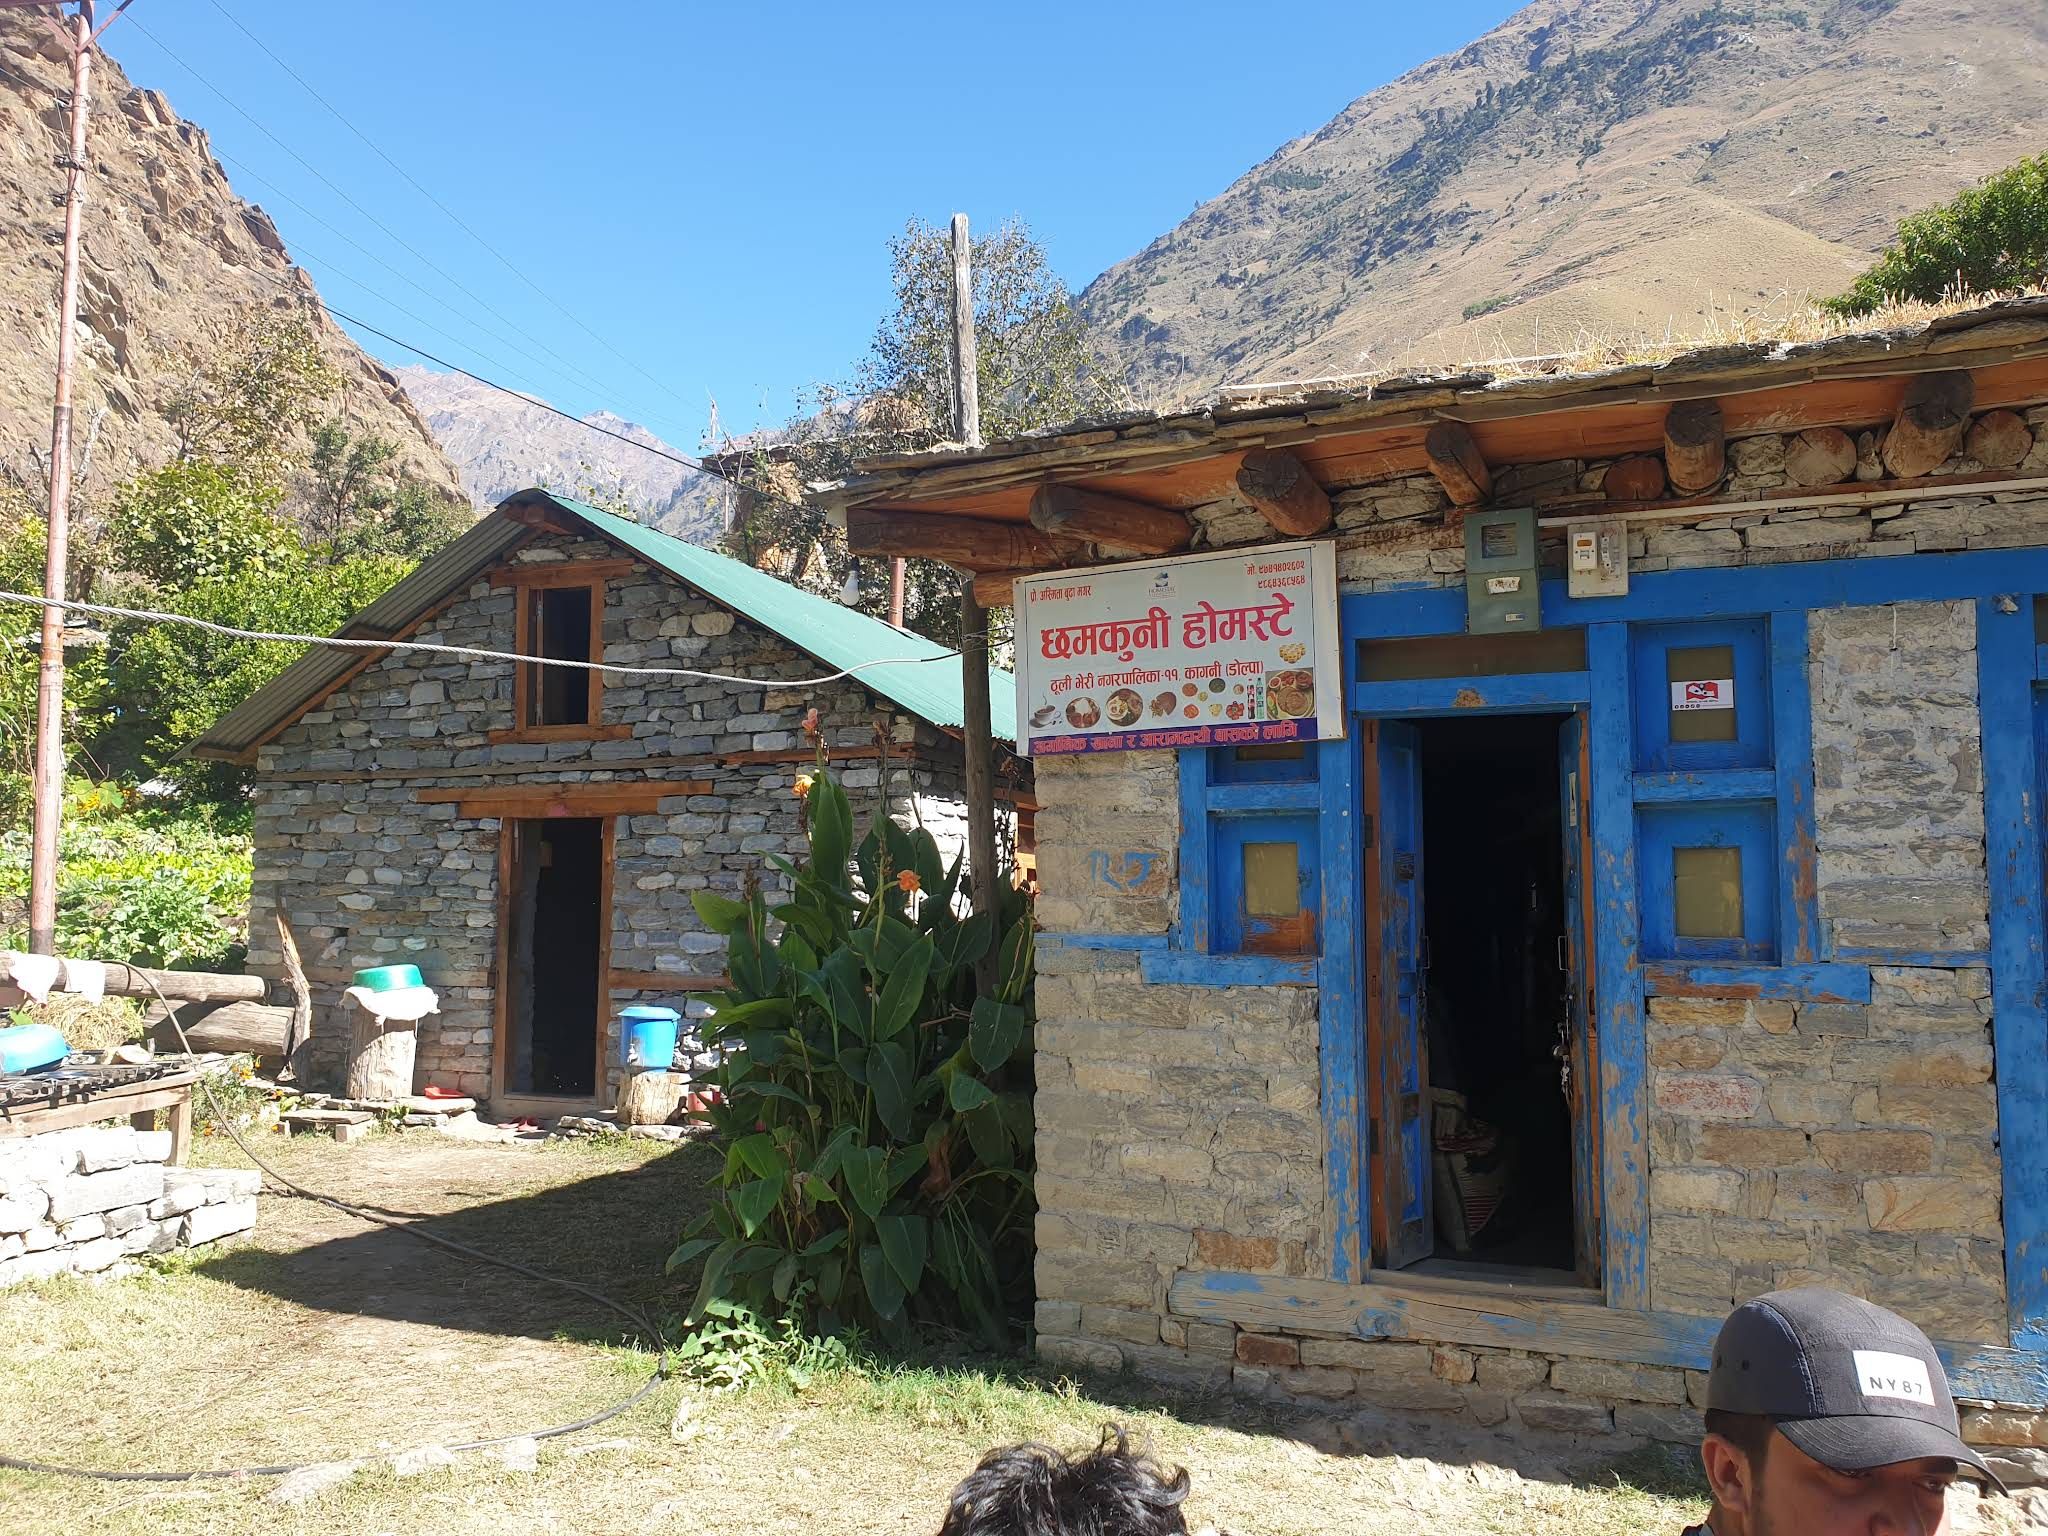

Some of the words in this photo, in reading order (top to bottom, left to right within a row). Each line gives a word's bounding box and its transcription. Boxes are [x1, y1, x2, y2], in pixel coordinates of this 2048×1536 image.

[1040, 587, 1063, 601] अस्मिता
[1040, 606, 1172, 662] छमकुनी
[1182, 592, 1295, 649] होमस्टे
[1050, 674, 1073, 695] ठूली
[1075, 672, 1094, 690] भेरी
[1184, 660, 1222, 680] कागनी
[1225, 658, 1264, 677] (डोल्पा)
[1127, 734, 1137, 749] र
[1263, 719, 1298, 740] लागि
[1869, 1376, 1923, 1396] NY87
